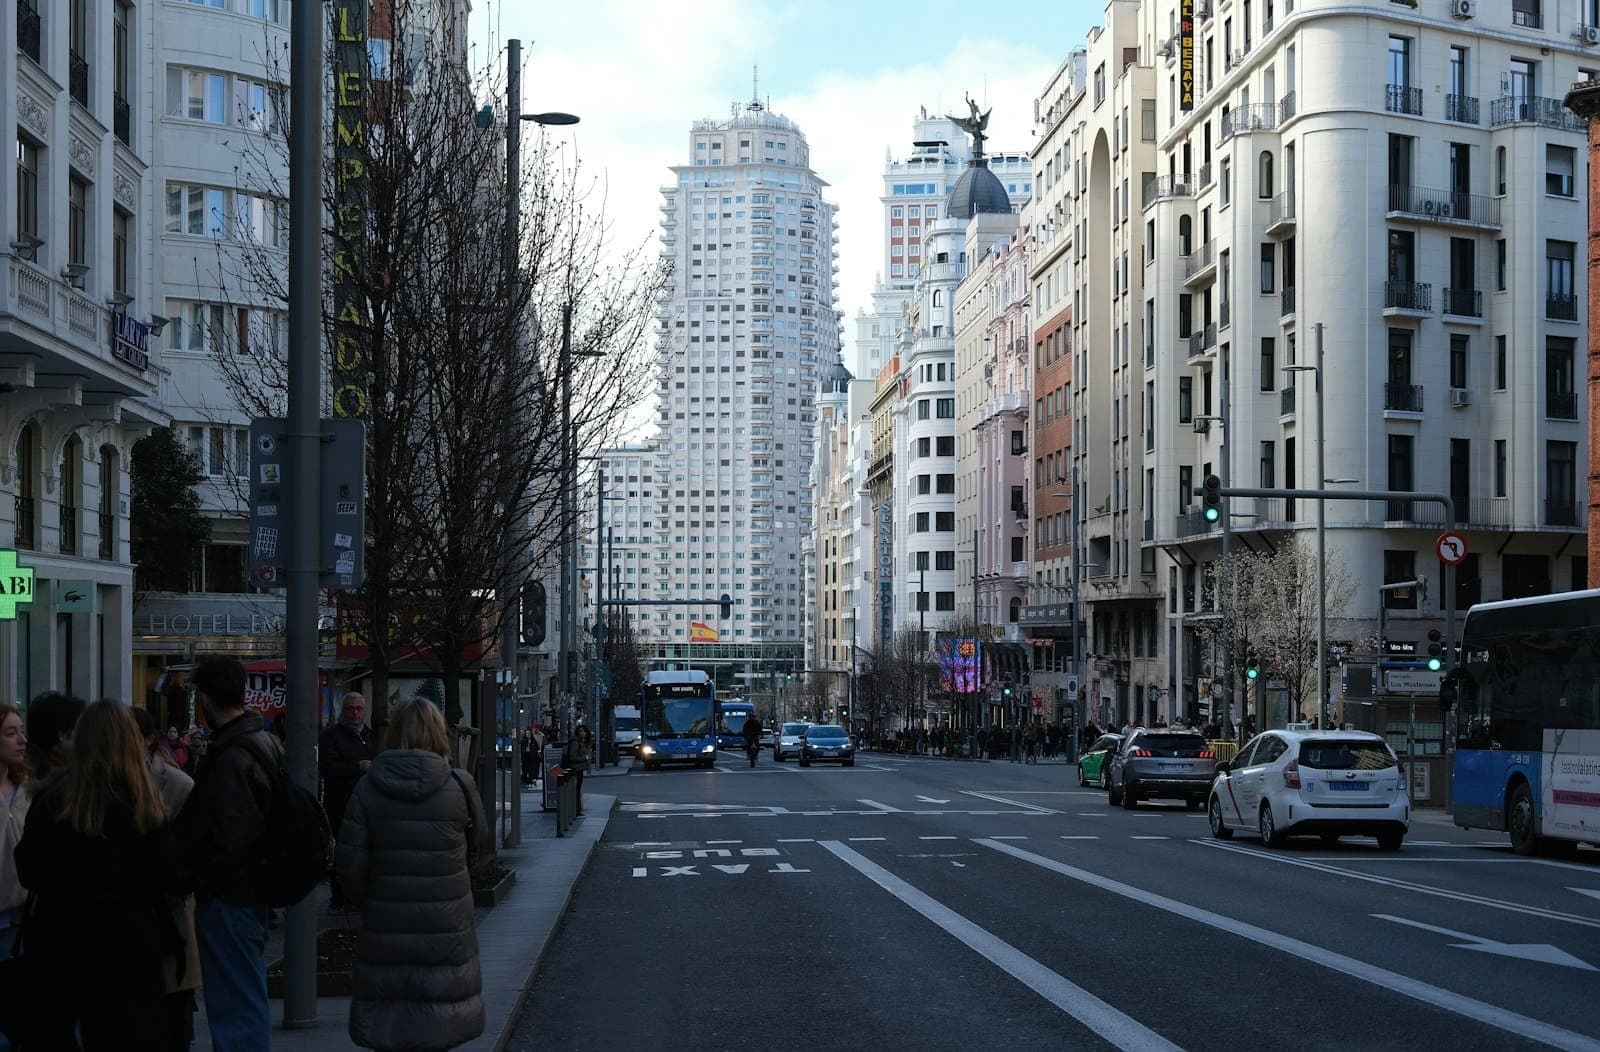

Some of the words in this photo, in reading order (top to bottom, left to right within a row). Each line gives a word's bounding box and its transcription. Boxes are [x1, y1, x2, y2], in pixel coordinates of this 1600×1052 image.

[1182, 37, 1193, 104] BESAYA
[880, 502, 891, 577] SENATOR
[151, 615, 236, 633] HOTEL
[646, 848, 781, 859] BUS
[632, 863, 812, 878] TAXI
